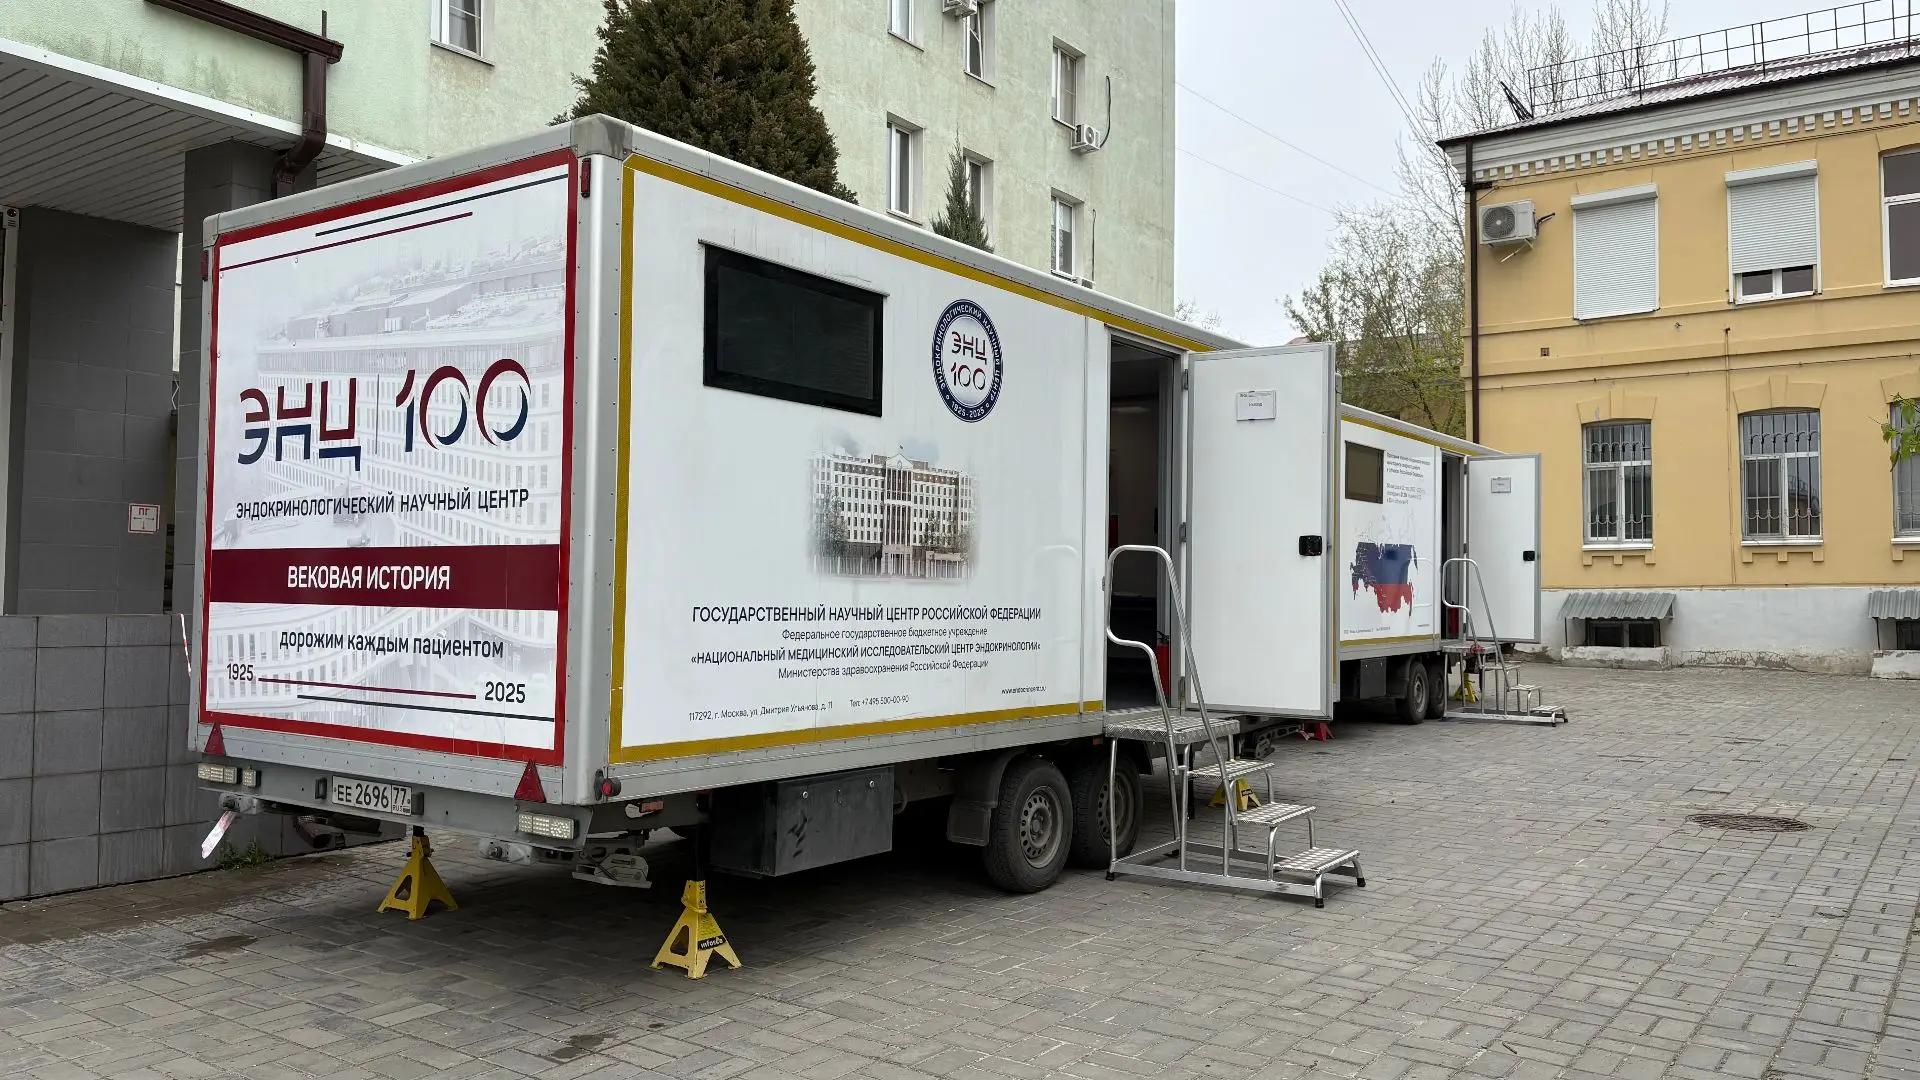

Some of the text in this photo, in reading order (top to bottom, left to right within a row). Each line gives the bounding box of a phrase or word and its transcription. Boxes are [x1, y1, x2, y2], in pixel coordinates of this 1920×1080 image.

[951, 331, 987, 365] ЭНЦ
[950, 362, 987, 391] 100
[238, 358, 532, 472] ЭНЦ 100
[139, 507, 151, 515] ПГ
[236, 487, 530, 519] ЭНДОКРИНОЛОГИЧЕСКИЙ НАУЧНЫЙ ЦЕНТР
[287, 565, 451, 591] ВЕКОВАЯ ИСТОРИЯ
[692, 603, 1041, 624] ГОСУДАРСТВЕННЫЙ НАУЧНЫЙ ЦЕНТР РОССИЙСКОЙ ФЕДЕРАЦИИ
[279, 630, 504, 659] дорожим каждым пациентом
[782, 627, 988, 642] Федеральное государственное бюджетное учреждение
[691, 647, 785, 665] «НАЦИОНАЛЬНЫЙ
[788, 645, 858, 661] МЕДИЦИНСКИЙ
[861, 642, 950, 658] ИССЛЕДОВАТЕЛЬСКИЙ
[951, 643, 974, 655] ЦЕНТР
[227, 662, 254, 682] 1925
[778, 659, 989, 679] Министерства здравоохранения Российской Федерации
[484, 681, 526, 704] 2025
[688, 710, 714, 721] 117292,
[721, 709, 749, 719] Москва,
[355, 783, 389, 808] 2696
[393, 787, 406, 805] 77
